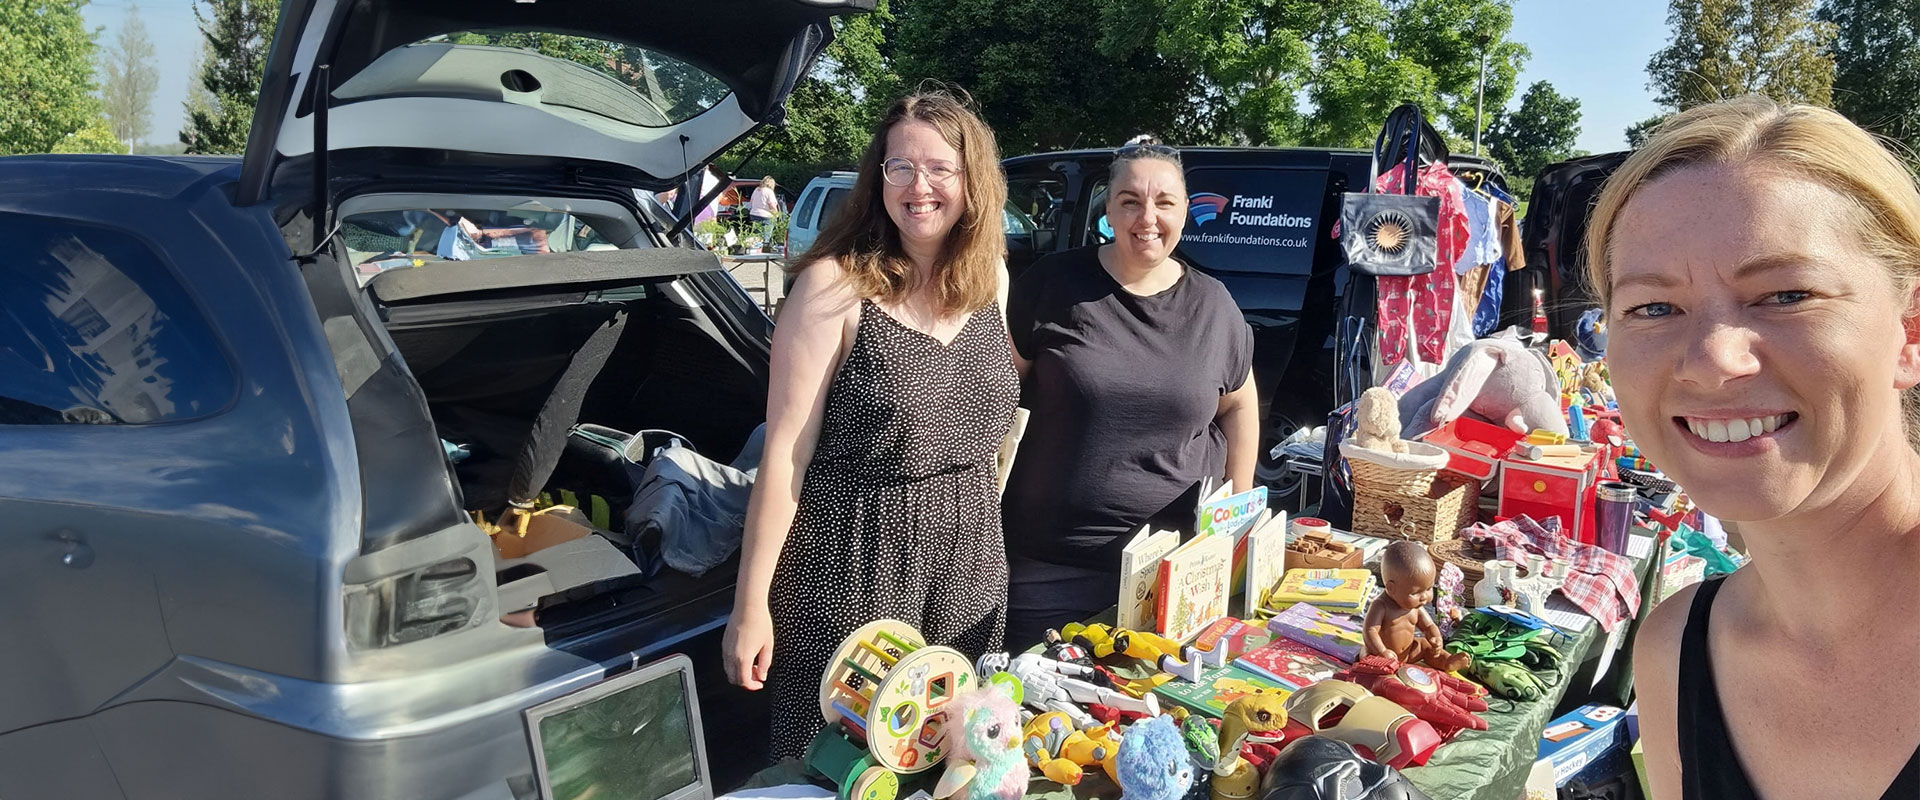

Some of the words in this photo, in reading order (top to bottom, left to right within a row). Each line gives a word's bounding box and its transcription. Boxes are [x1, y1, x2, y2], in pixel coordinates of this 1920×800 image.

[1232, 195, 1273, 209] Franki
[1229, 212, 1312, 228] Foundations
[1213, 501, 1256, 524] Colours
[1137, 546, 1164, 566] Where's
[1185, 562, 1225, 586] Christmas
[1190, 579, 1211, 597] Wish
[1177, 687, 1192, 696] to
[1202, 667, 1233, 682] Farm
[1560, 757, 1585, 776] Hockey
